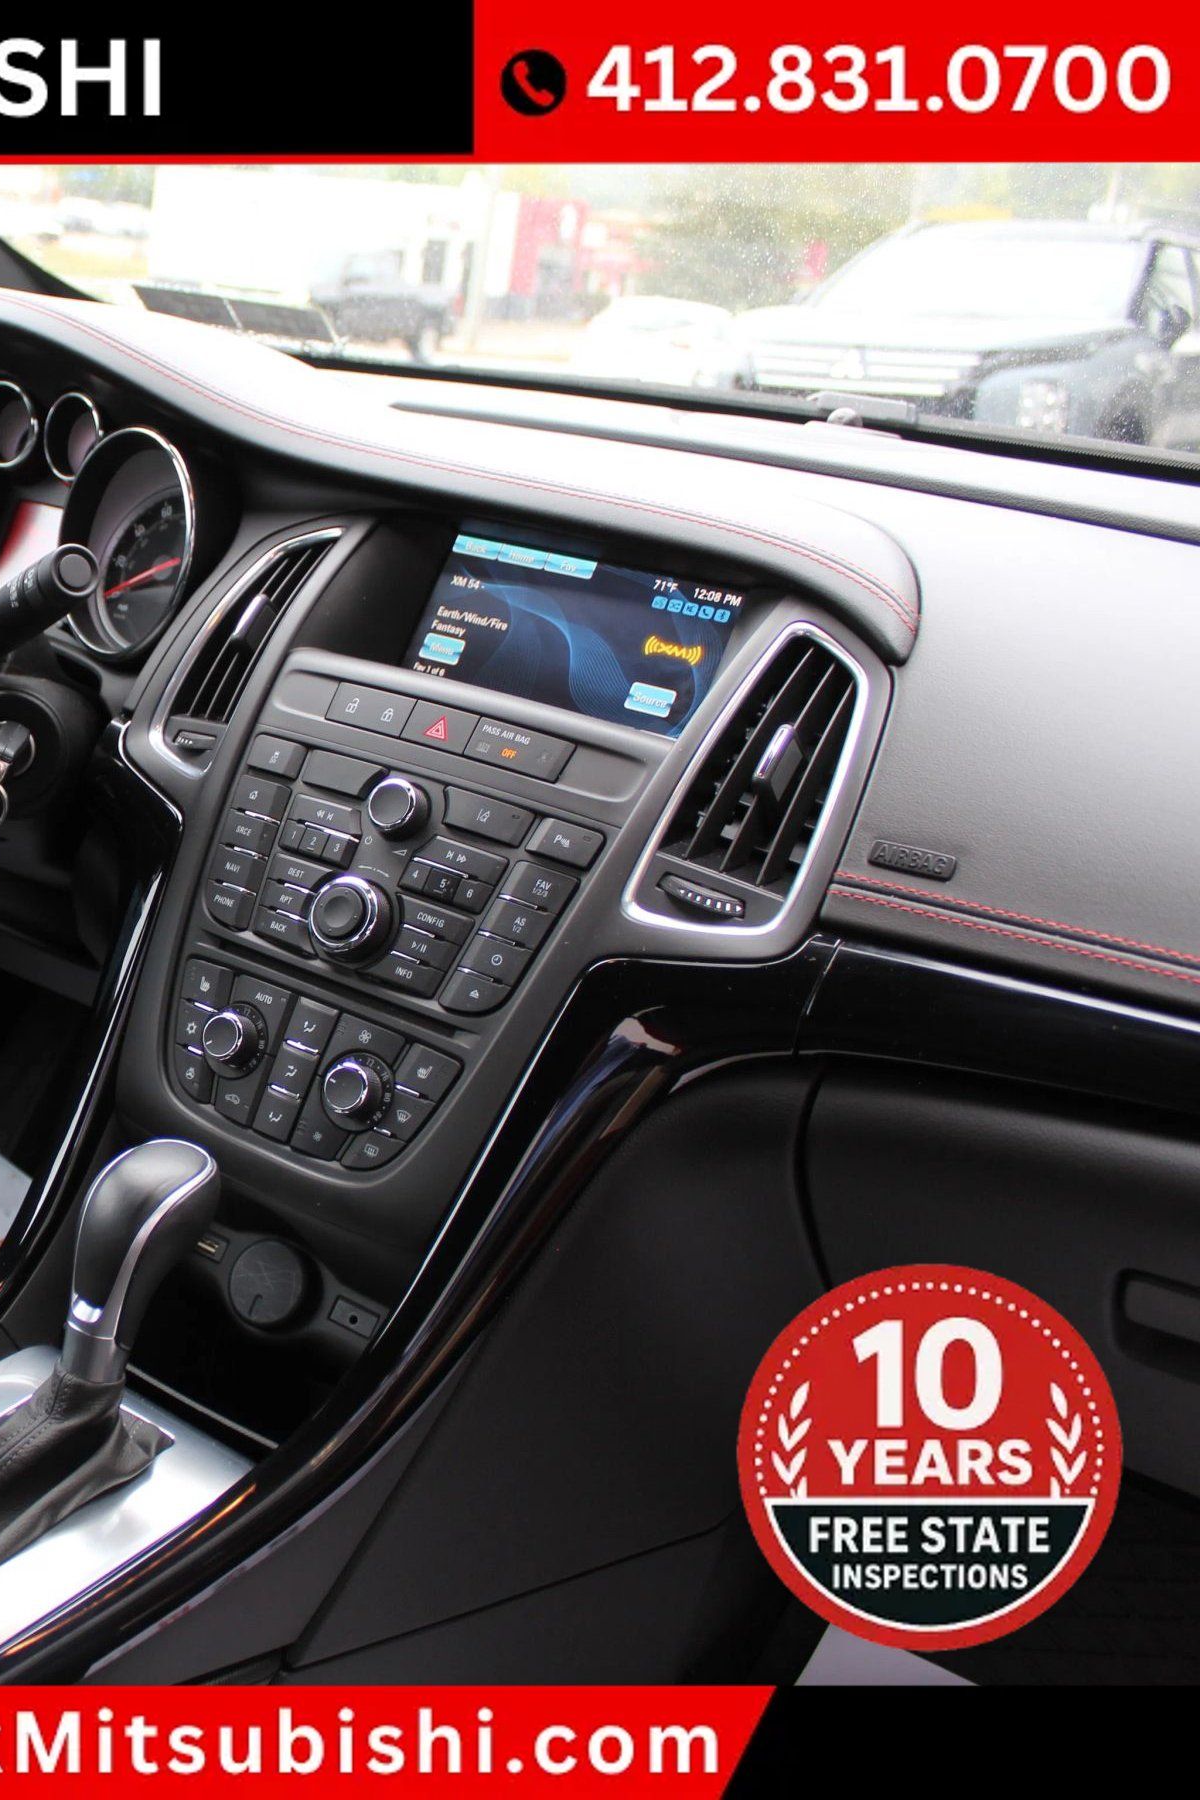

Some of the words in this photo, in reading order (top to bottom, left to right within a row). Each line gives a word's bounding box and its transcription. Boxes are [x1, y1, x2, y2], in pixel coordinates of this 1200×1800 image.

[450, 575, 466, 588] XM
[467, 578, 481, 590] 54
[653, 579, 679, 594] 71°F
[693, 587, 721, 603] 12:08
[722, 593, 743, 607] PM
[437, 605, 509, 632] Earth/Wind/Fire
[431, 619, 467, 638] Fantasy
[413, 662, 427, 673] Fav
[431, 666, 440, 676] of
[634, 690, 668, 709] Source
[482, 723, 501, 736] PASS
[500, 730, 515, 741] AIR
[514, 734, 531, 746] BAG
[501, 747, 518, 760] OFF
[235, 824, 252, 837] SRCE
[310, 836, 318, 846] 2
[333, 843, 341, 853] 3
[873, 843, 948, 874] AIRBAG
[224, 861, 241, 874] NAVI
[287, 867, 305, 880] DEST
[412, 869, 419, 880] 4
[535, 878, 552, 892] FAV
[279, 893, 293, 905] RPT
[466, 888, 474, 899] 6
[213, 893, 236, 909] PHONE
[270, 920, 288, 933] BACK
[417, 911, 446, 929] CONFIG
[514, 916, 527, 928] AS
[395, 965, 414, 980] INFO
[255, 991, 274, 1006] AUTO
